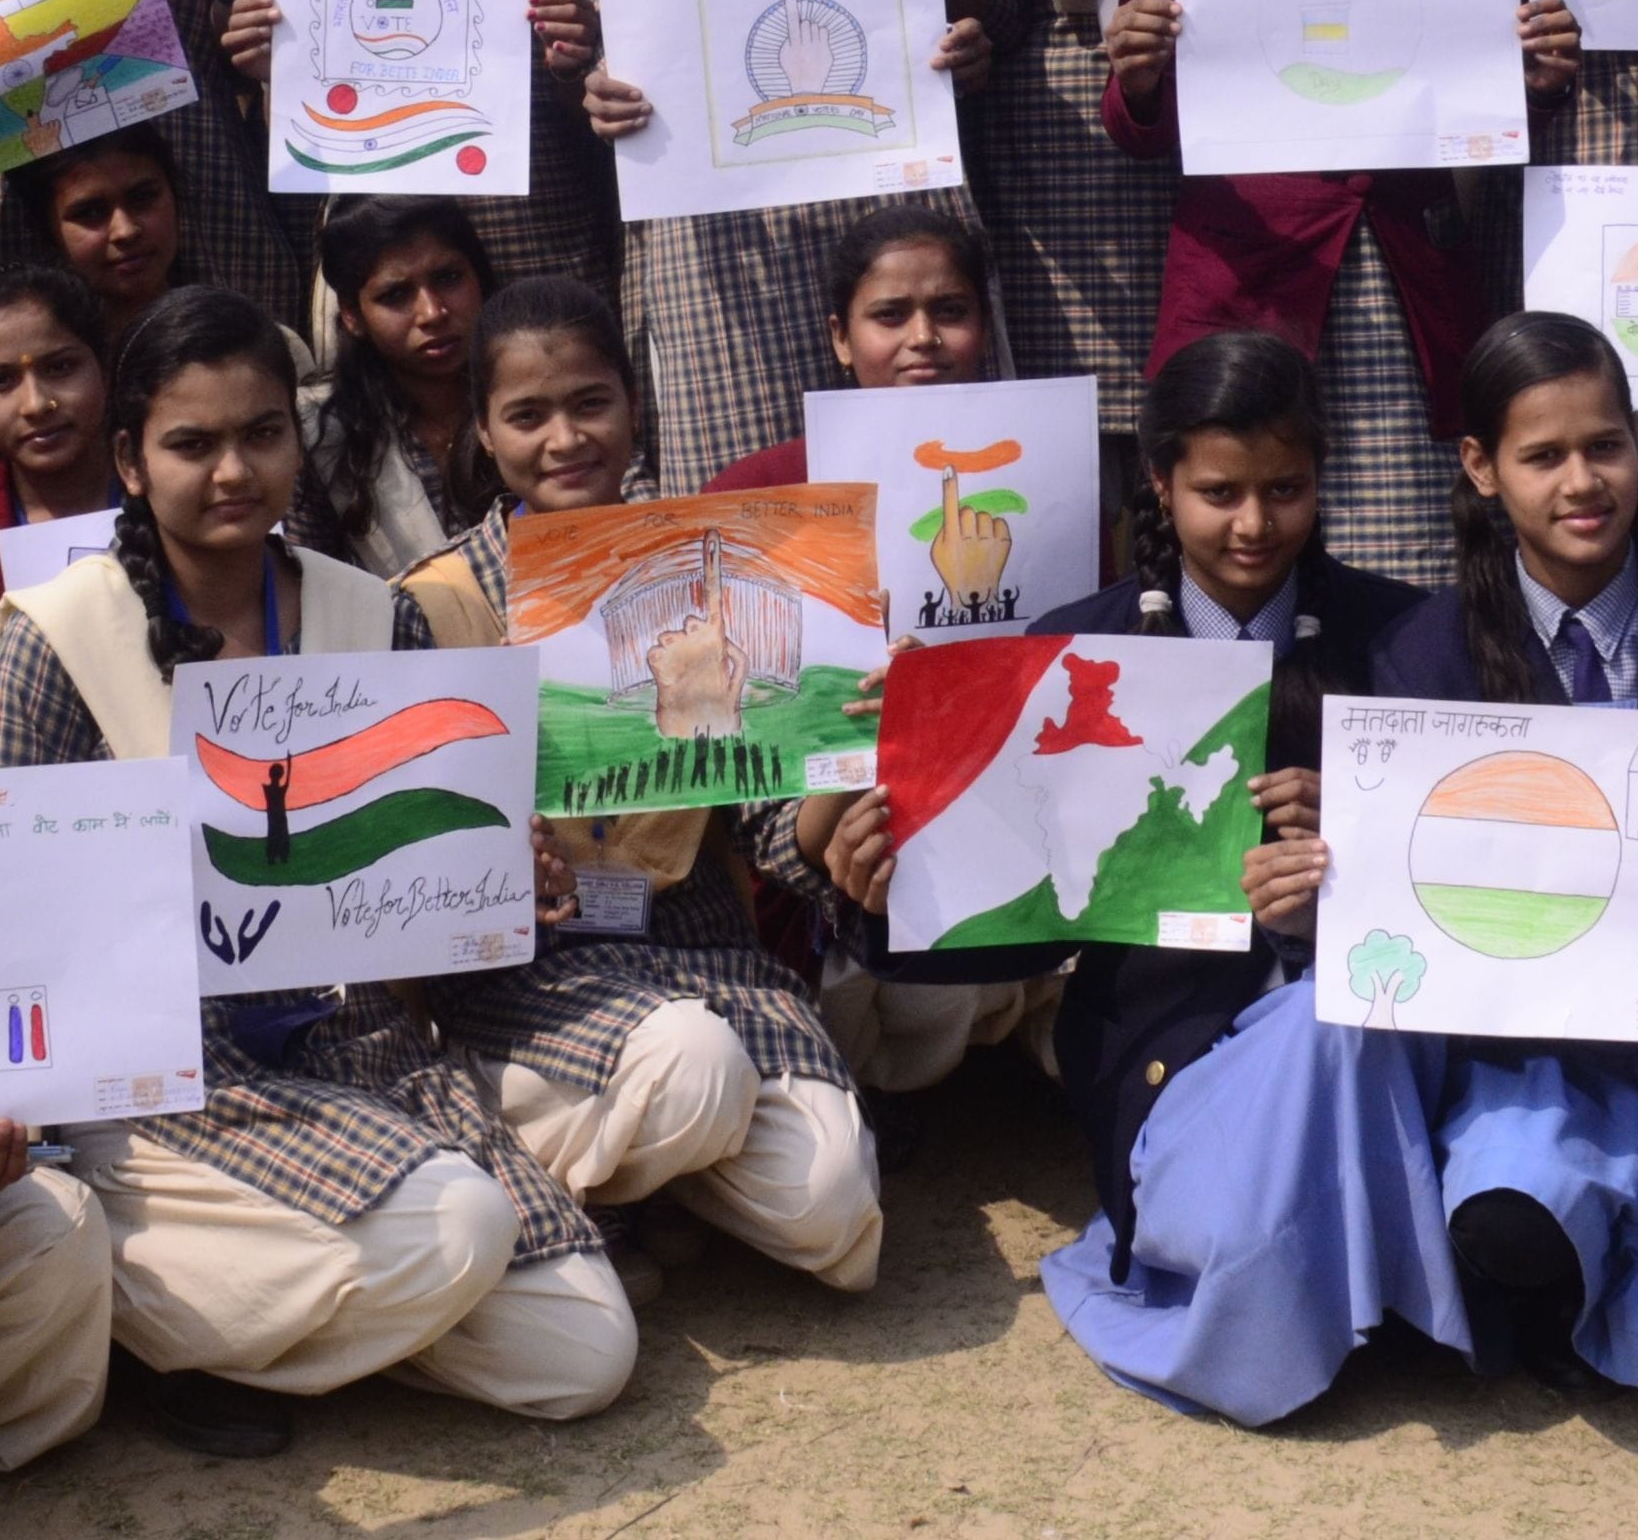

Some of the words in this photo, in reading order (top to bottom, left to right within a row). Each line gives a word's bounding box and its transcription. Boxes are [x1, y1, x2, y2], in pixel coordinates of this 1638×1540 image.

[360, 15, 412, 32] VOTE
[536, 525, 579, 544] VOTE
[643, 510, 679, 527] FOR
[740, 502, 804, 520] BETTER
[813, 502, 855, 518] INDIA
[1341, 707, 1427, 734] मतदाता
